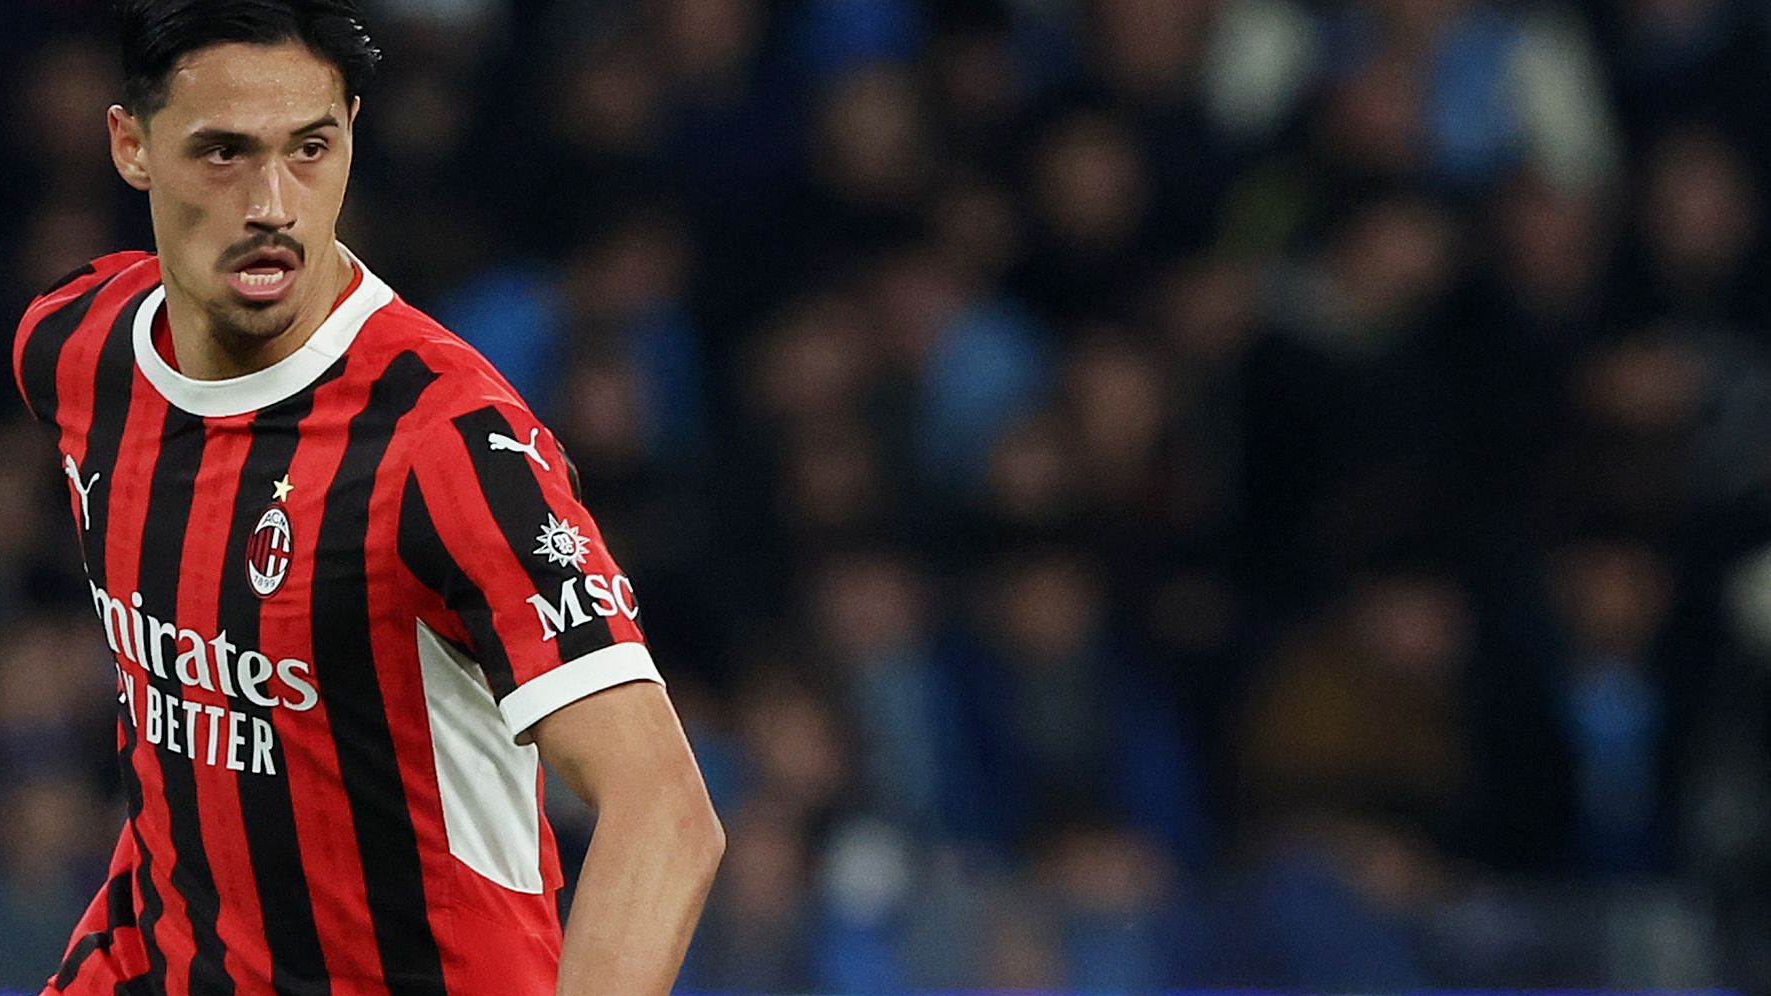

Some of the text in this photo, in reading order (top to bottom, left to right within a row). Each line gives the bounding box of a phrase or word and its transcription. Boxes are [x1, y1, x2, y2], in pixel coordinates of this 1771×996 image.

[254, 574, 276, 588] 1899
[525, 574, 640, 642] MSC
[85, 564, 319, 712] mirates
[145, 683, 277, 776] BETTER
